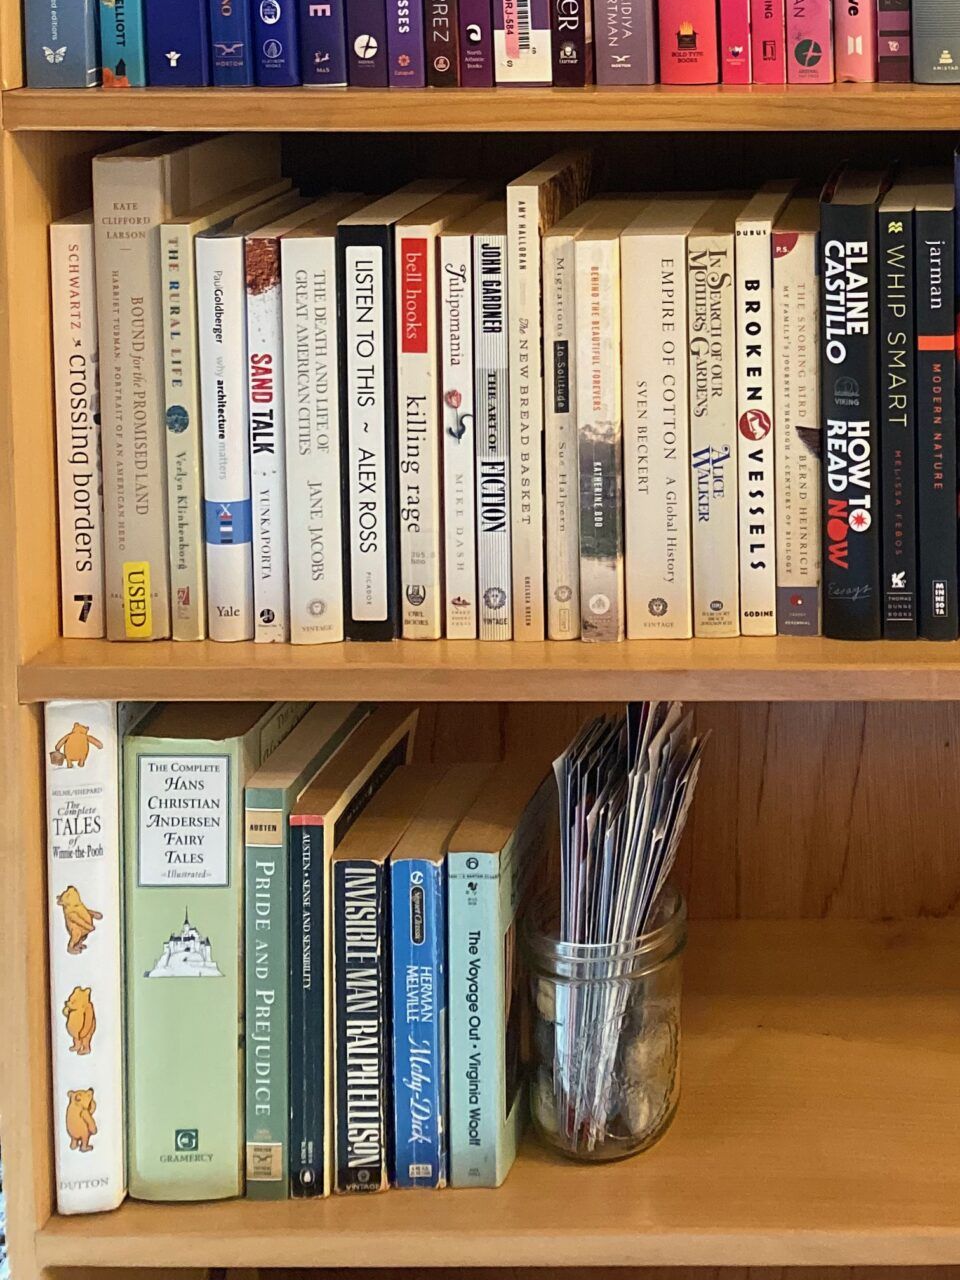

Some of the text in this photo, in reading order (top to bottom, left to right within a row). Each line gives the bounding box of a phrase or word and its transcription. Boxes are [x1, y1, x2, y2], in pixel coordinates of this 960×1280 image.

[406, 253, 423, 340] bell hooks
[445, 264, 466, 366] Tulipomania
[824, 240, 846, 365] CASTILLO
[845, 241, 868, 335] ELAINE
[927, 240, 942, 310] jarman
[355, 261, 377, 553] LISTEN TO THIS ALEX ROSS
[744, 279, 765, 571] BROKEN VESSELS
[69, 354, 93, 573] crossing borders
[399, 395, 426, 534] killing rage
[826, 419, 846, 493] READ
[848, 420, 871, 532] HOW TO
[129, 570, 146, 627] USED
[217, 605, 240, 618] Yale
[148, 763, 167, 773] THE
[53, 818, 102, 836] TALES
[164, 850, 204, 864] TALES
[255, 938, 269, 980] AND
[345, 867, 380, 1168] INVISIBLE MAN RALPH ELLISON
[467, 930, 480, 1146] The Voyage Out Virginia Woolf
[407, 1037, 433, 1144] Moby-Dick
[160, 1154, 212, 1163] GRAMERCY
